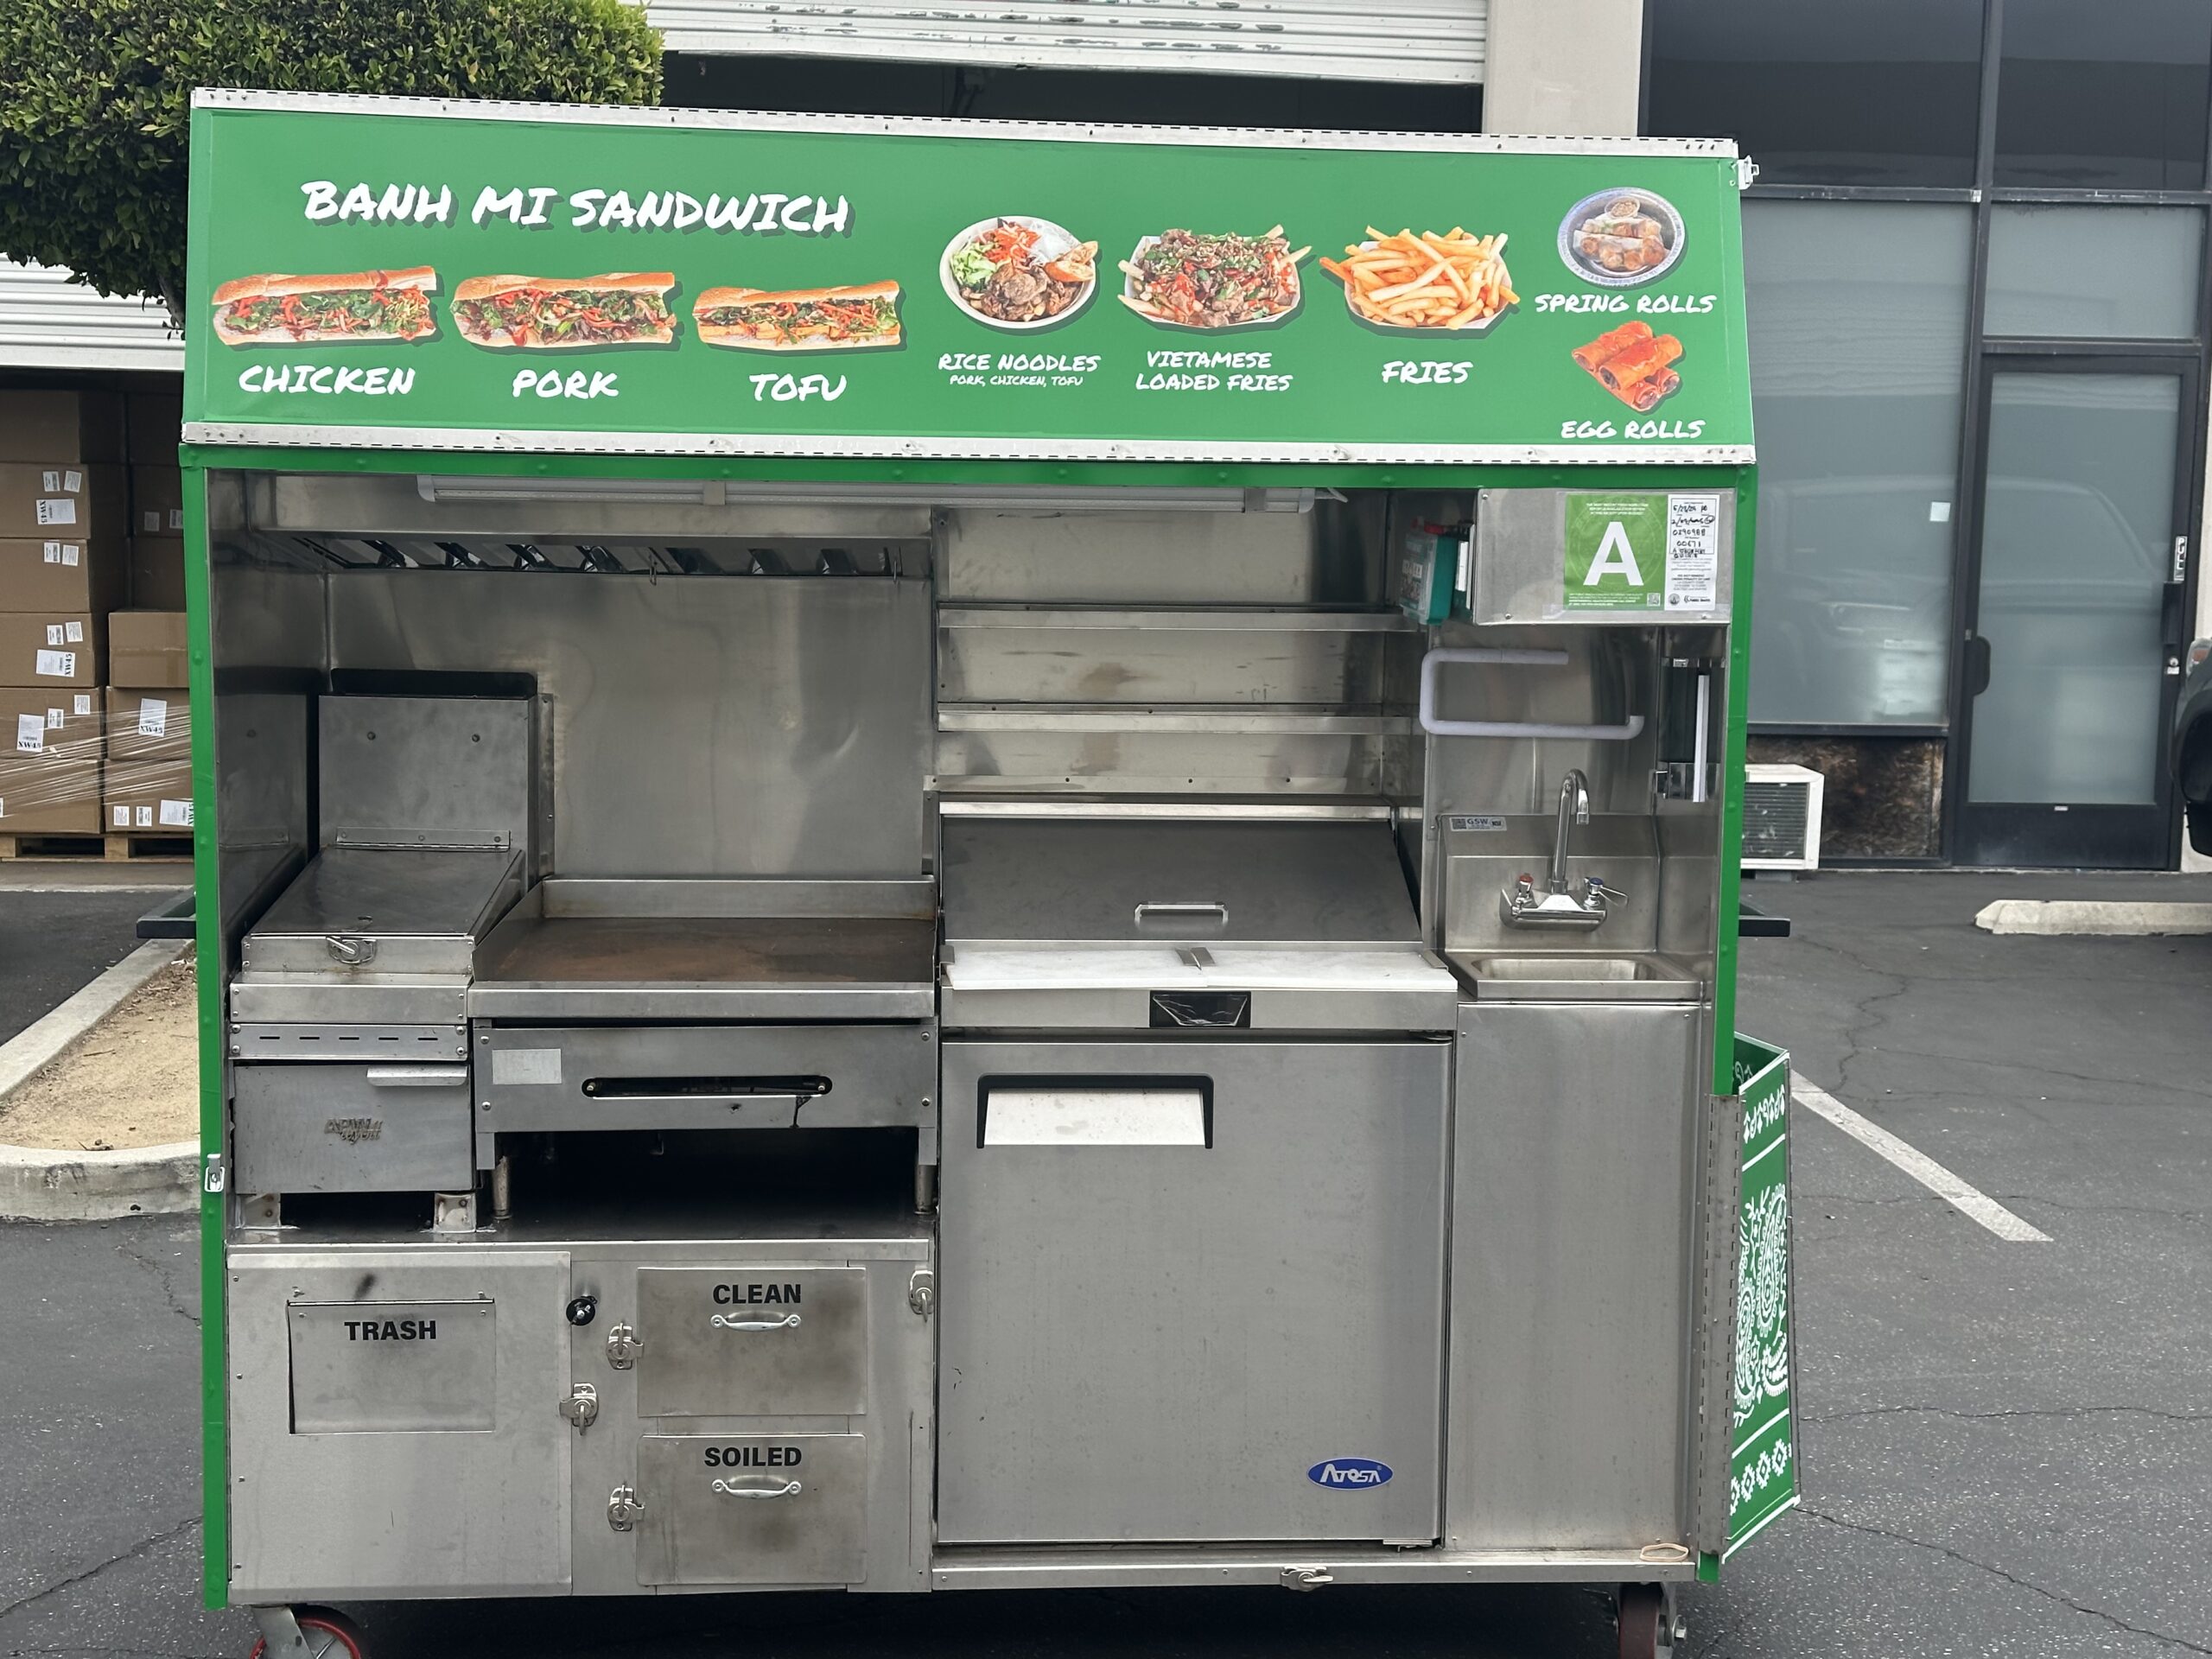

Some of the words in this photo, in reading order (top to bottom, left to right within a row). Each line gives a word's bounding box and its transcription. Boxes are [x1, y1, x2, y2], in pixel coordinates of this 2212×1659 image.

[300, 180, 452, 223] BANH
[471, 185, 558, 226] MI
[569, 188, 849, 233] SANDWICH
[1534, 293, 1630, 314] SPRING
[1636, 294, 1718, 315] ROLLS
[938, 353, 992, 371] RICE
[997, 353, 1102, 372] NOODLES
[1147, 350, 1273, 369] VIETAMESE
[238, 364, 416, 396] CHICKEN
[950, 374, 986, 387] PORK,
[989, 374, 1047, 388] CHICKEN,
[1051, 375, 1084, 386] TOFU
[1135, 372, 1221, 391] LOADED
[1226, 373, 1294, 392] FRIES
[1381, 360, 1474, 385] FRIES
[512, 369, 620, 400] PORK
[748, 372, 848, 402] TOFU
[1560, 420, 1618, 439] EGG
[1624, 419, 1707, 440] ROLLS
[1582, 521, 1644, 586] A
[713, 1284, 801, 1305] CLEAN
[344, 1320, 436, 1341] TRASH
[704, 1446, 802, 1467] SOILED
